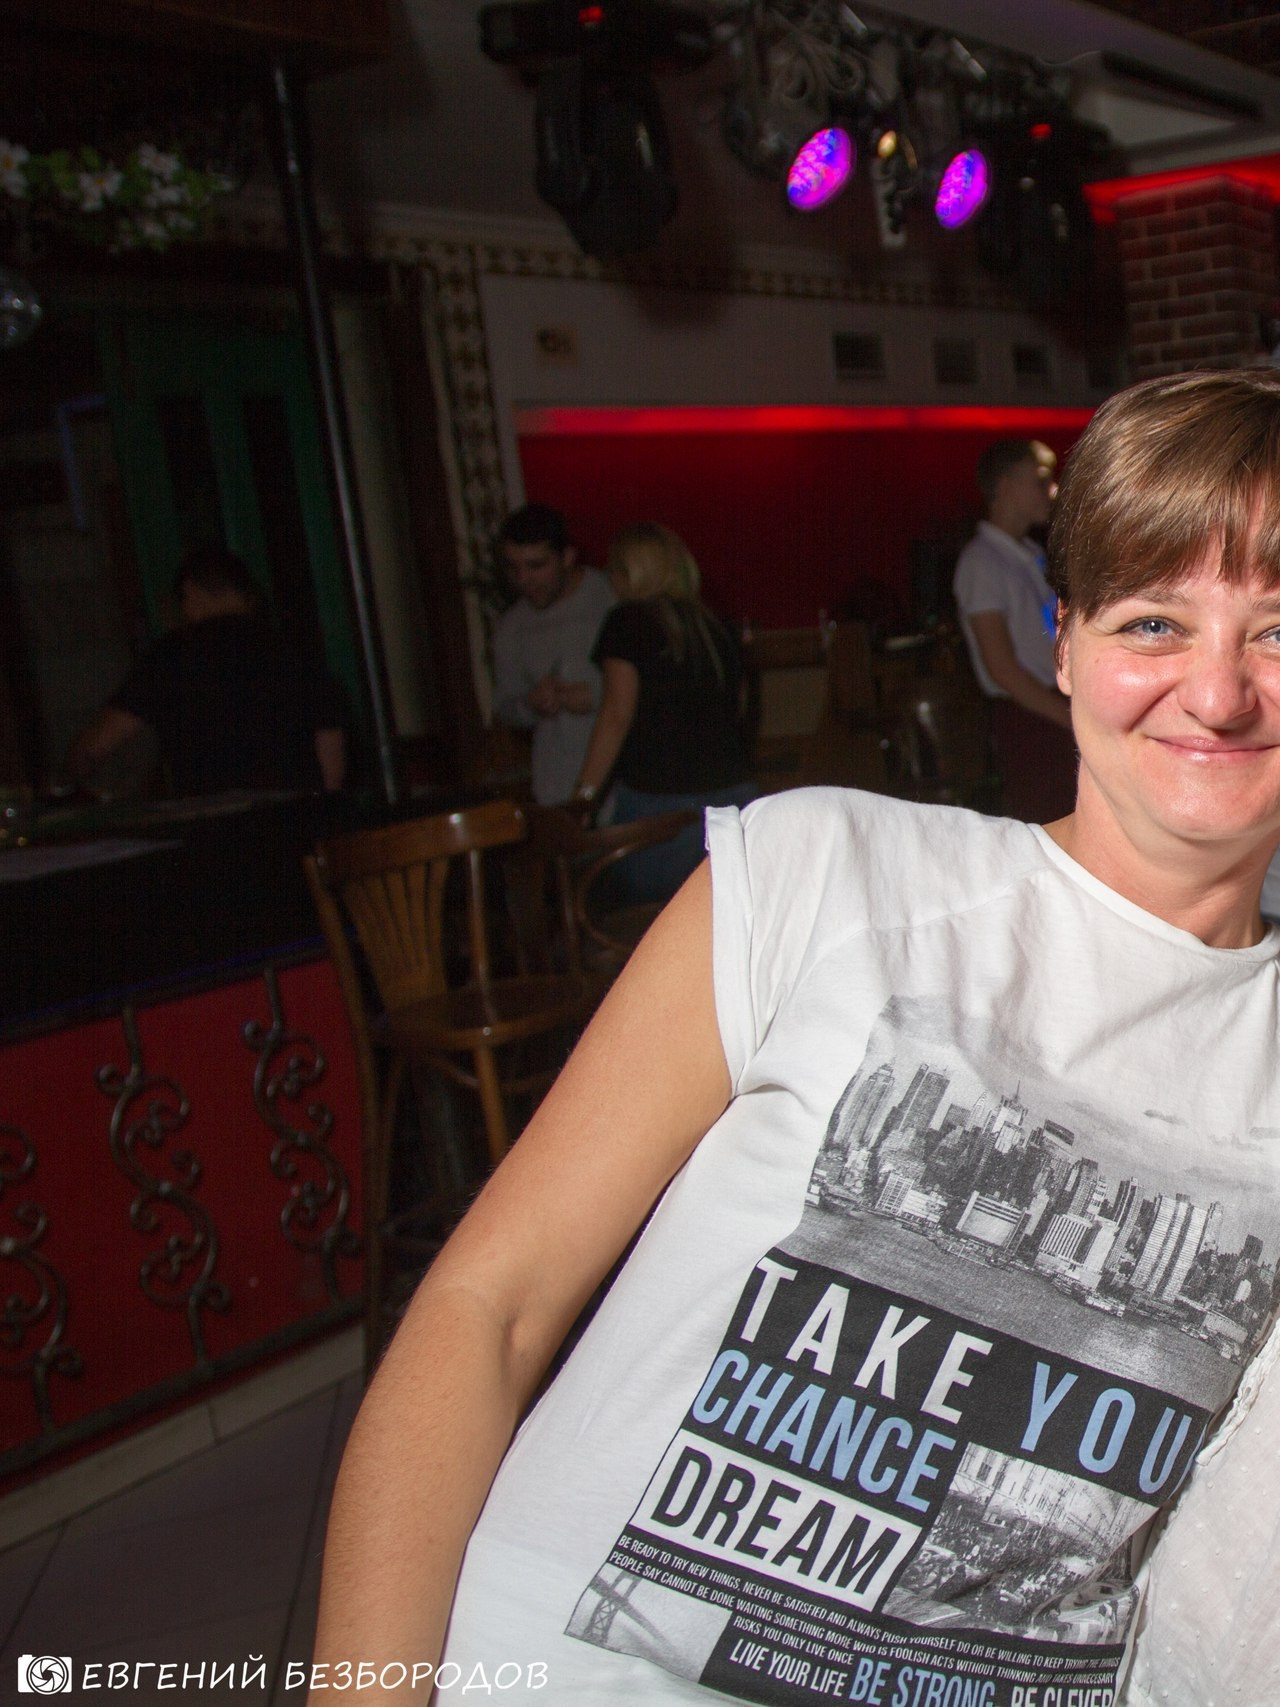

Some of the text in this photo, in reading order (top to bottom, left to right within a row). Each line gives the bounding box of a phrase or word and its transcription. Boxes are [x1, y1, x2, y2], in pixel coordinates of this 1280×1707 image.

[692, 1349, 957, 1513] CHANCE
[739, 1256, 1208, 1499] TAKE YOU
[649, 1445, 903, 1597] DREAM
[609, 1551, 644, 1574] PEOPLE
[642, 1565, 662, 1580] SAY
[660, 1572, 699, 1593] CANNOT
[697, 1585, 710, 1598] BE
[710, 1590, 734, 1607] DONE
[737, 1599, 773, 1621] WAITING
[773, 1612, 825, 1639] SOMETHING
[825, 1630, 852, 1650] MORE
[853, 1640, 876, 1653] WHO
[878, 1646, 888, 1655] IS
[890, 1647, 930, 1665] FOOLISH
[930, 1655, 955, 1670] ACTS
[956, 1660, 996, 1676] WITHOUT
[996, 1666, 1036, 1683] THINKING
[618, 1535, 630, 1548] BE
[630, 1540, 660, 1560] READY
[659, 1551, 672, 1564] TO
[671, 1556, 690, 1571] TRY
[688, 1562, 710, 1579] NEW
[742, 1582, 772, 1601] NEVER
[771, 1592, 785, 1605] BE
[784, 1596, 828, 1620] SATISFIED
[826, 1611, 847, 1627] AND
[846, 1618, 882, 1640] ALWAYS
[881, 1632, 907, 1644] PUSH
[909, 1635, 957, 1650] YOURSELF
[956, 1641, 970, 1653] DO
[971, 1644, 985, 1656] OR
[985, 1647, 997, 1659] BE
[998, 1649, 1032, 1666] WILLING
[1032, 1655, 1044, 1667] TO
[1044, 1657, 1063, 1669] KEEP
[733, 1615, 855, 1665] RISKS YOU ONLY LIVE ONCE
[729, 1638, 769, 1671] LIVE
[767, 1651, 811, 1687] YOUR
[810, 1666, 848, 1697] LIFE
[849, 1657, 892, 1706] BE
